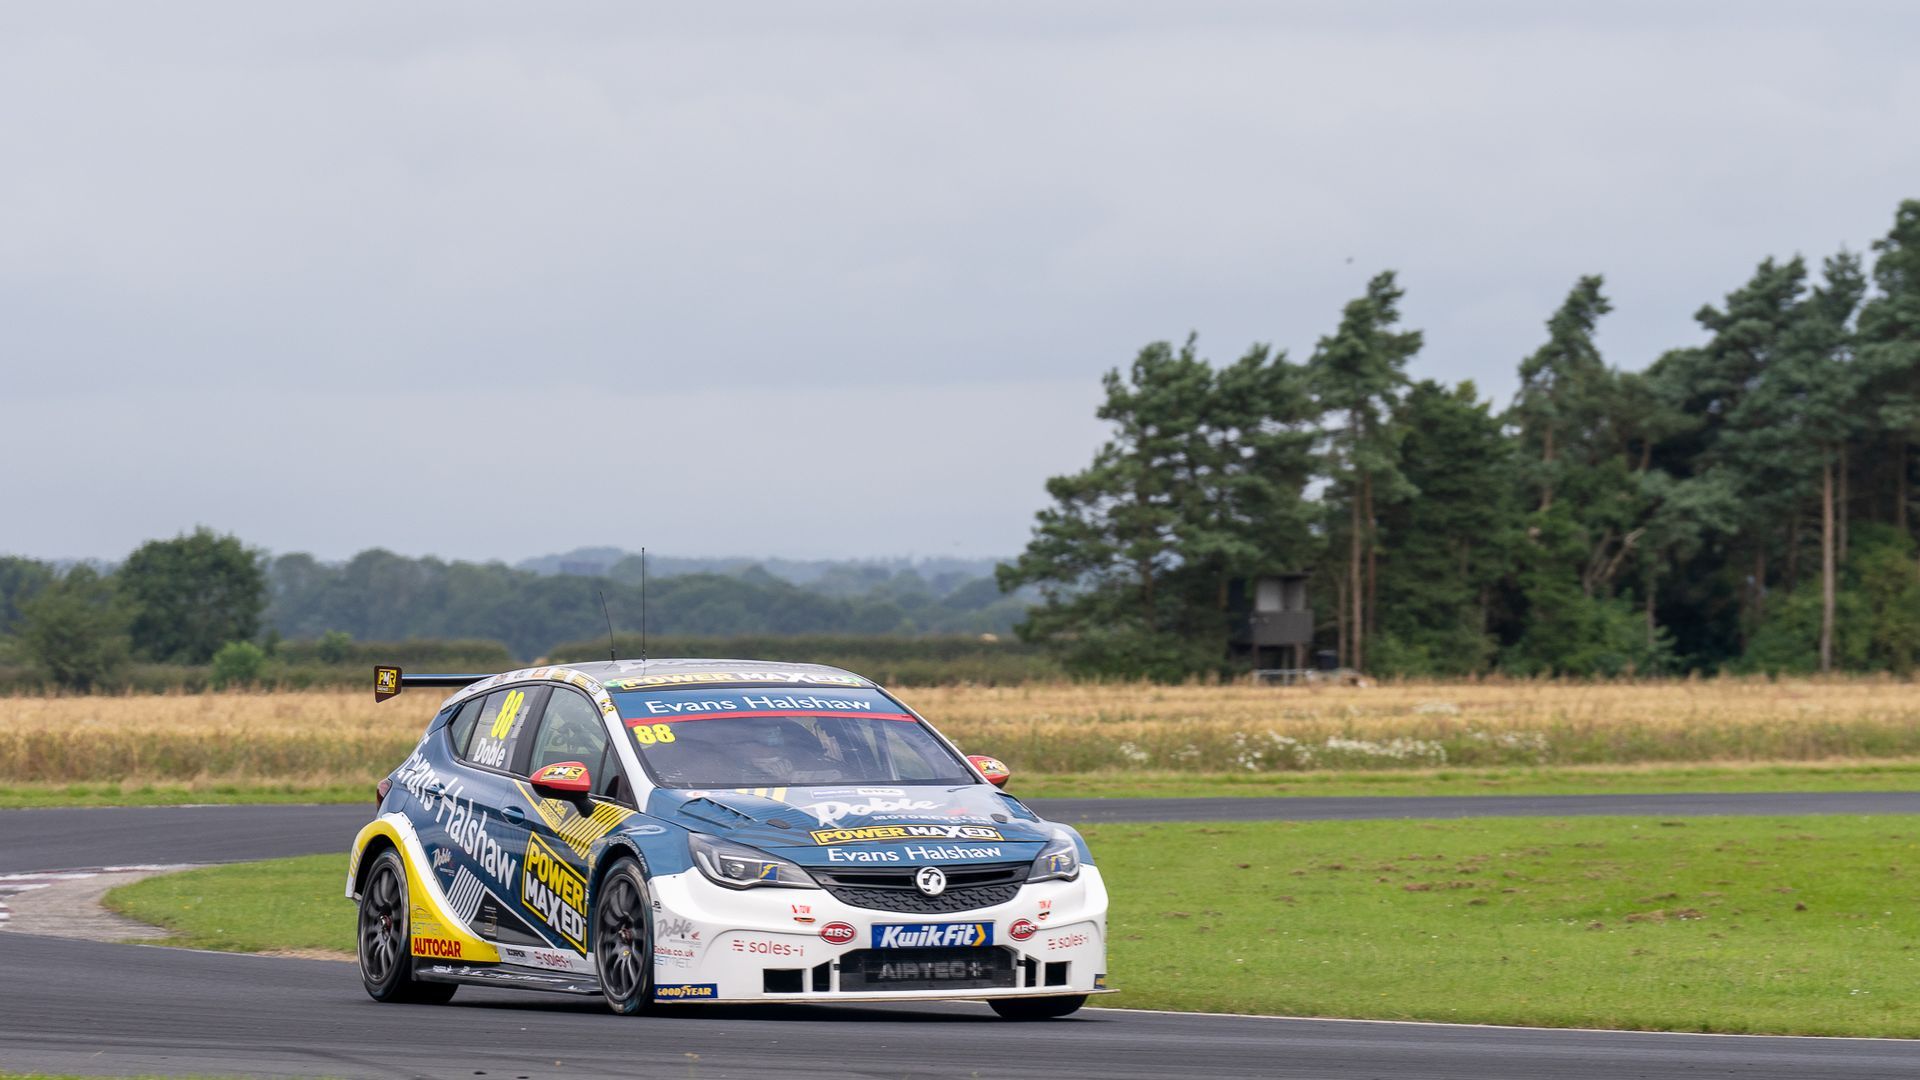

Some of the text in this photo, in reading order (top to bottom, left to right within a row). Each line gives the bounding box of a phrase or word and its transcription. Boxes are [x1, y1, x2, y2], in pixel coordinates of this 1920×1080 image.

[377, 671, 397, 686] PMR
[622, 672, 857, 687] POWER MAXED
[645, 696, 871, 714] Evans Halshaw
[491, 690, 525, 740] 88
[633, 723, 676, 745] 88
[473, 737, 507, 769] Doble
[397, 732, 517, 891] Evans Halshaw
[799, 797, 946, 828] Doble
[816, 825, 997, 844] POWER MAXED
[827, 846, 1002, 862] Evans Halshaw
[526, 841, 585, 916] POWER
[524, 872, 584, 943] MAXED
[656, 918, 697, 940] Doble
[824, 927, 855, 939] ABS
[1012, 924, 1038, 935] ABS
[413, 937, 462, 958] AUTOCAR
[748, 940, 805, 957] sales-i
[542, 950, 574, 968] sales-i
[877, 961, 967, 980] AIRTEC
[656, 985, 713, 999] GOODYEAR
